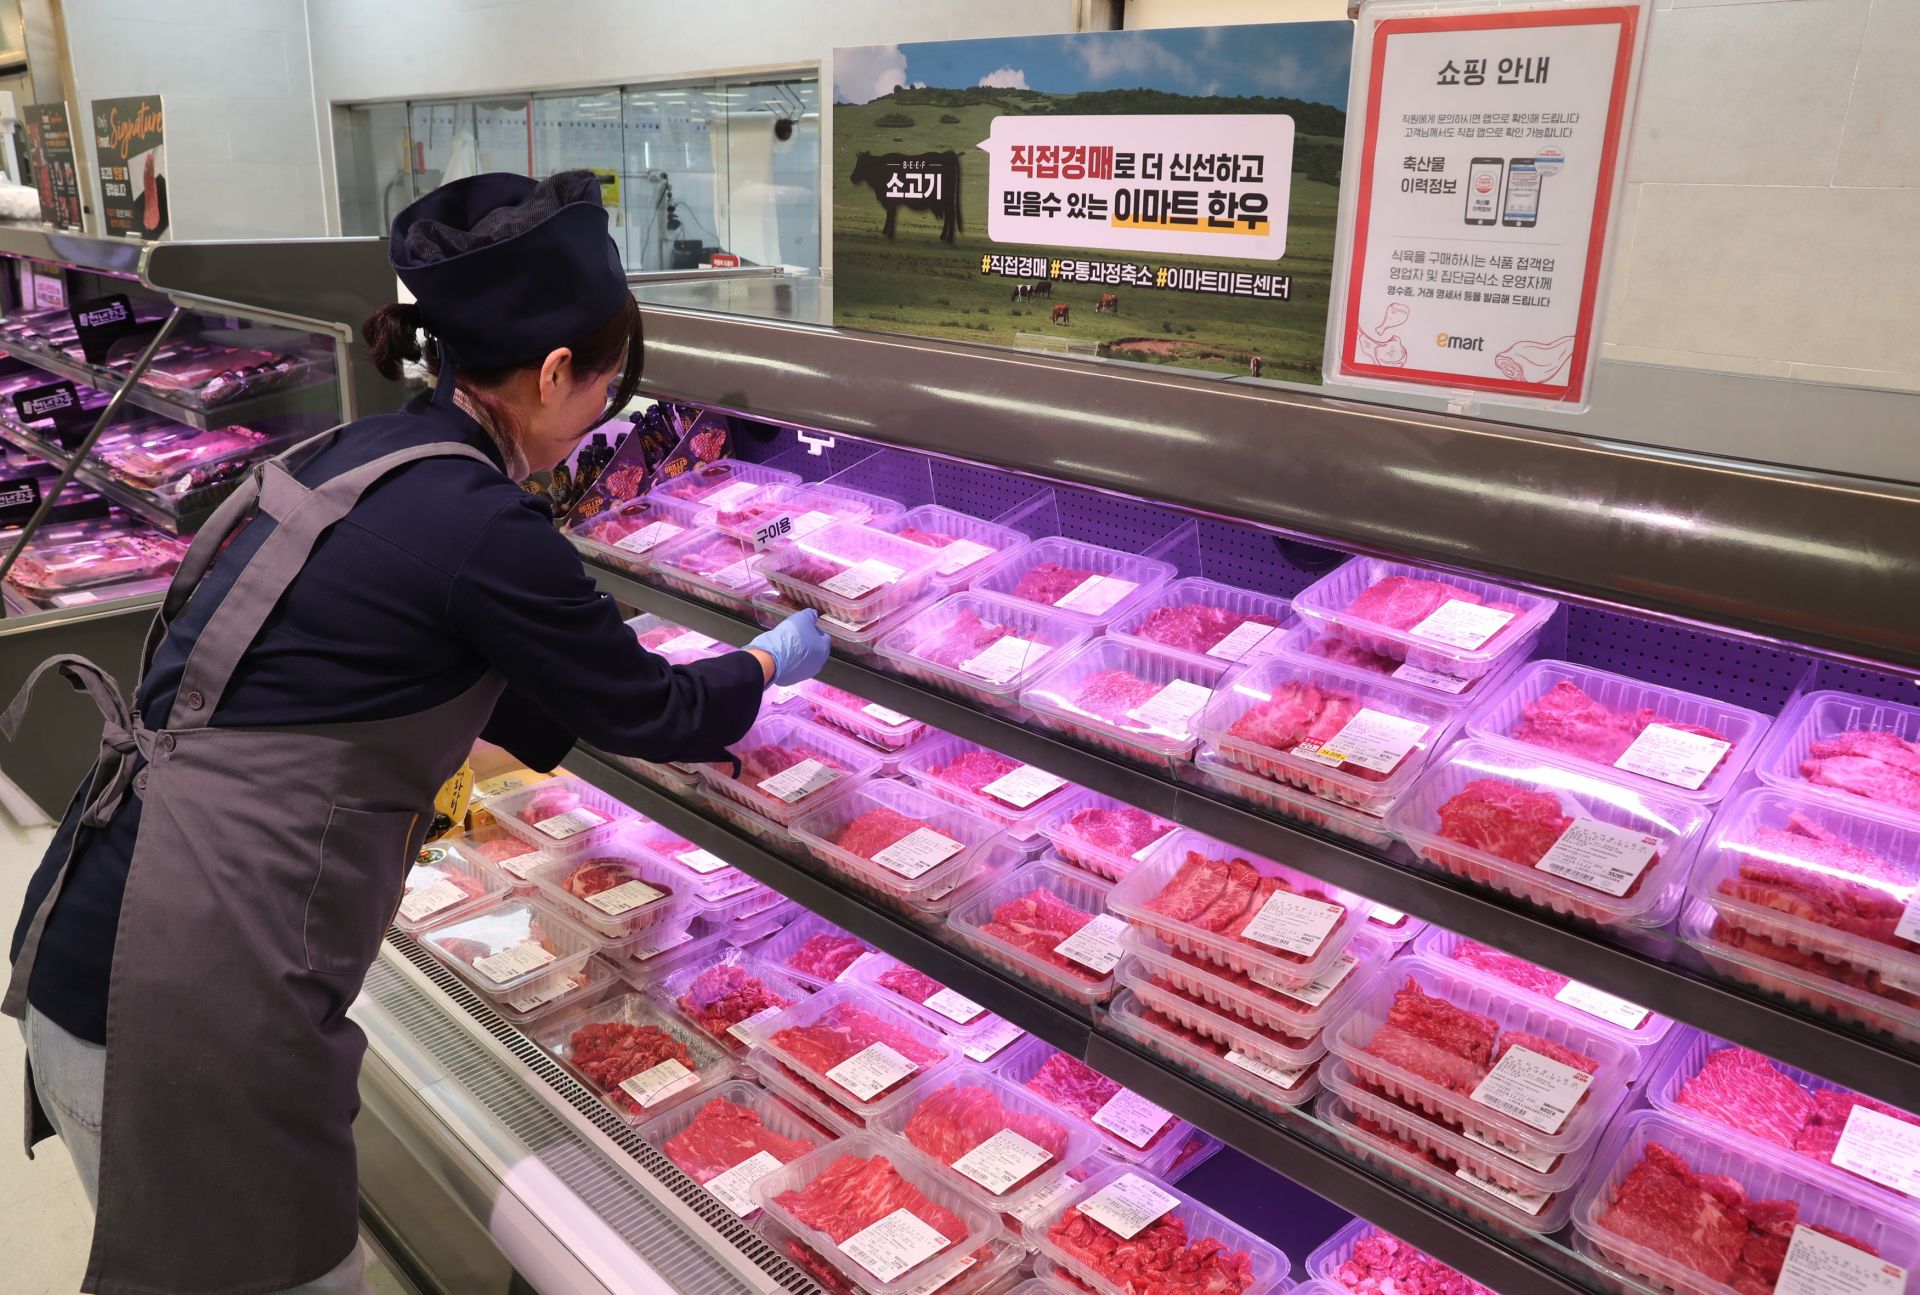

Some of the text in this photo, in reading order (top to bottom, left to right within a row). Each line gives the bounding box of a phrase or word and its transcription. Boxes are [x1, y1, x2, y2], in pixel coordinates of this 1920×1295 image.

[1437, 57, 1550, 85] 쇼핑 안내
[1402, 113, 1580, 124] 직원에게 문의하시면 앱으로 확인해 드립니다
[1404, 127, 1573, 138] 고객님께서도 직접 앱으로 확인 가능합니다
[1010, 144, 1264, 183] 직접경매로 더 신선하고
[1403, 156, 1445, 172] 축산물
[886, 172, 942, 200] 소고기
[1401, 178, 1456, 194] 이력정보
[1004, 188, 1269, 230] 믿을수 있는 이마트 한우
[1392, 250, 1555, 272] 식육을 구매하시는 식품 접객업
[981, 254, 1289, 298] #직접경매 #유통과정축소 #이마트미트센터
[1390, 267, 1552, 290] 영업자 및 집단급식소 운영자께
[1417, 288, 1434, 298] 거래
[1436, 289, 1462, 300] 명세서
[1464, 291, 1481, 302] 등을
[1484, 292, 1509, 304] 발급해
[1512, 295, 1550, 307] 드립니다
[1436, 332, 1484, 351] emart
[757, 517, 791, 544] 구이용
